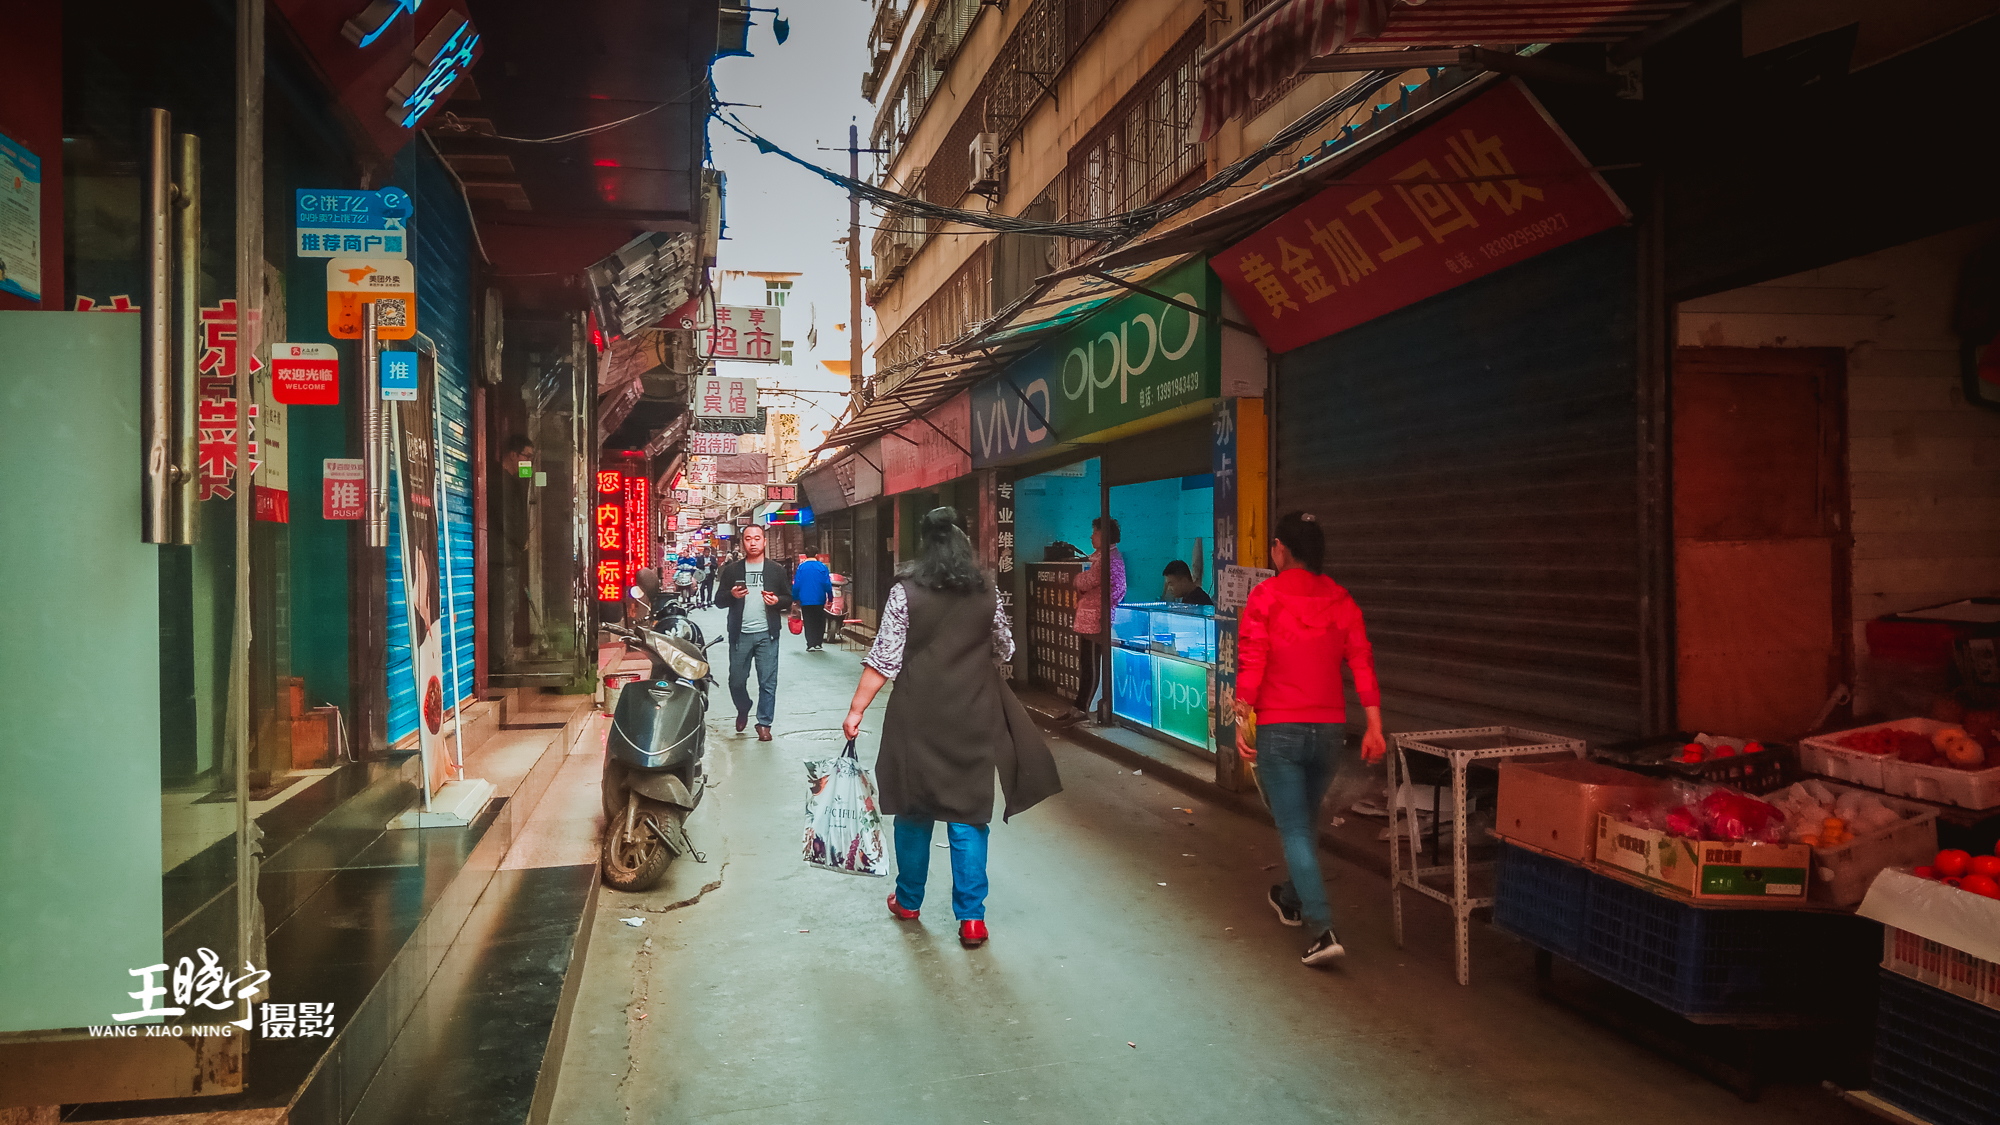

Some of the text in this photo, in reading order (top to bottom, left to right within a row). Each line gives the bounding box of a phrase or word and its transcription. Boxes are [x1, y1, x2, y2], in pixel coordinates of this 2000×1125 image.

[320, 195, 368, 212] 饿了么
[1239, 128, 1544, 319] 黄金加工回收
[301, 233, 383, 253] 推荐商户
[1479, 212, 1569, 260] 18302959827
[369, 275, 401, 284] 美团外卖
[706, 325, 774, 359] 超市
[1062, 292, 1200, 414] oppo
[278, 368, 333, 382] 欢迎光临
[389, 361, 409, 380] 推
[285, 383, 326, 391] WELCOME
[706, 380, 744, 396] 丹丹
[704, 395, 747, 414] 宾馆
[976, 379, 1049, 459] vivo
[692, 437, 737, 454] 招待所
[331, 481, 360, 509] 推
[998, 482, 1014, 573] 专业维修
